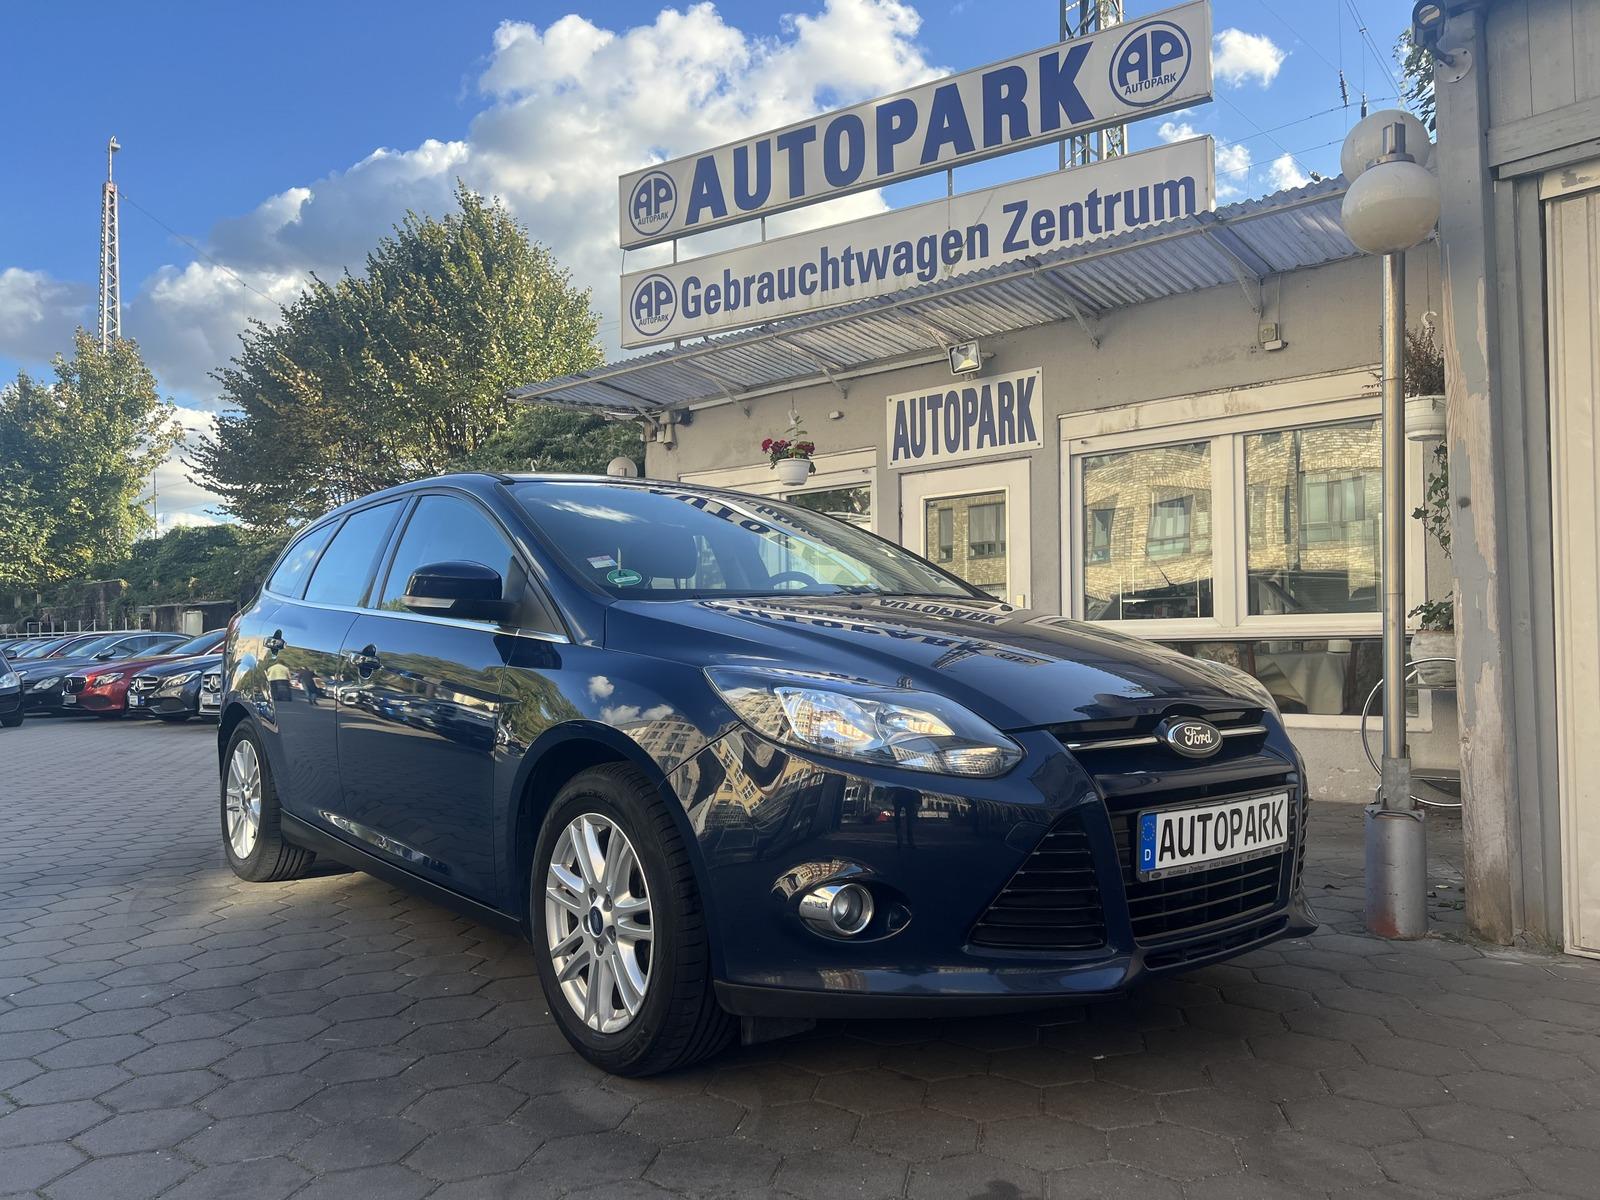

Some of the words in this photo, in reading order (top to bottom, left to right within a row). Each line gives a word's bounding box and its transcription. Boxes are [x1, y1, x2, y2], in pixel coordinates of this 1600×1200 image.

[1118, 30, 1184, 87] AP
[1124, 72, 1177, 96] AUTOPARK
[685, 41, 1094, 226] AUTOPARK
[634, 178, 673, 219] AP
[638, 211, 669, 226] AUTOPARK
[681, 222, 989, 319] Gebrauchtwagen
[1003, 175, 1196, 253] Zentrum
[635, 281, 673, 319] AP
[639, 313, 669, 326] AUTOPARK
[893, 376, 1037, 461] AUTOPARK
[1184, 726, 1213, 746] Ford
[1158, 799, 1284, 862] AUTOPARK
[1144, 849, 1151, 861] D
